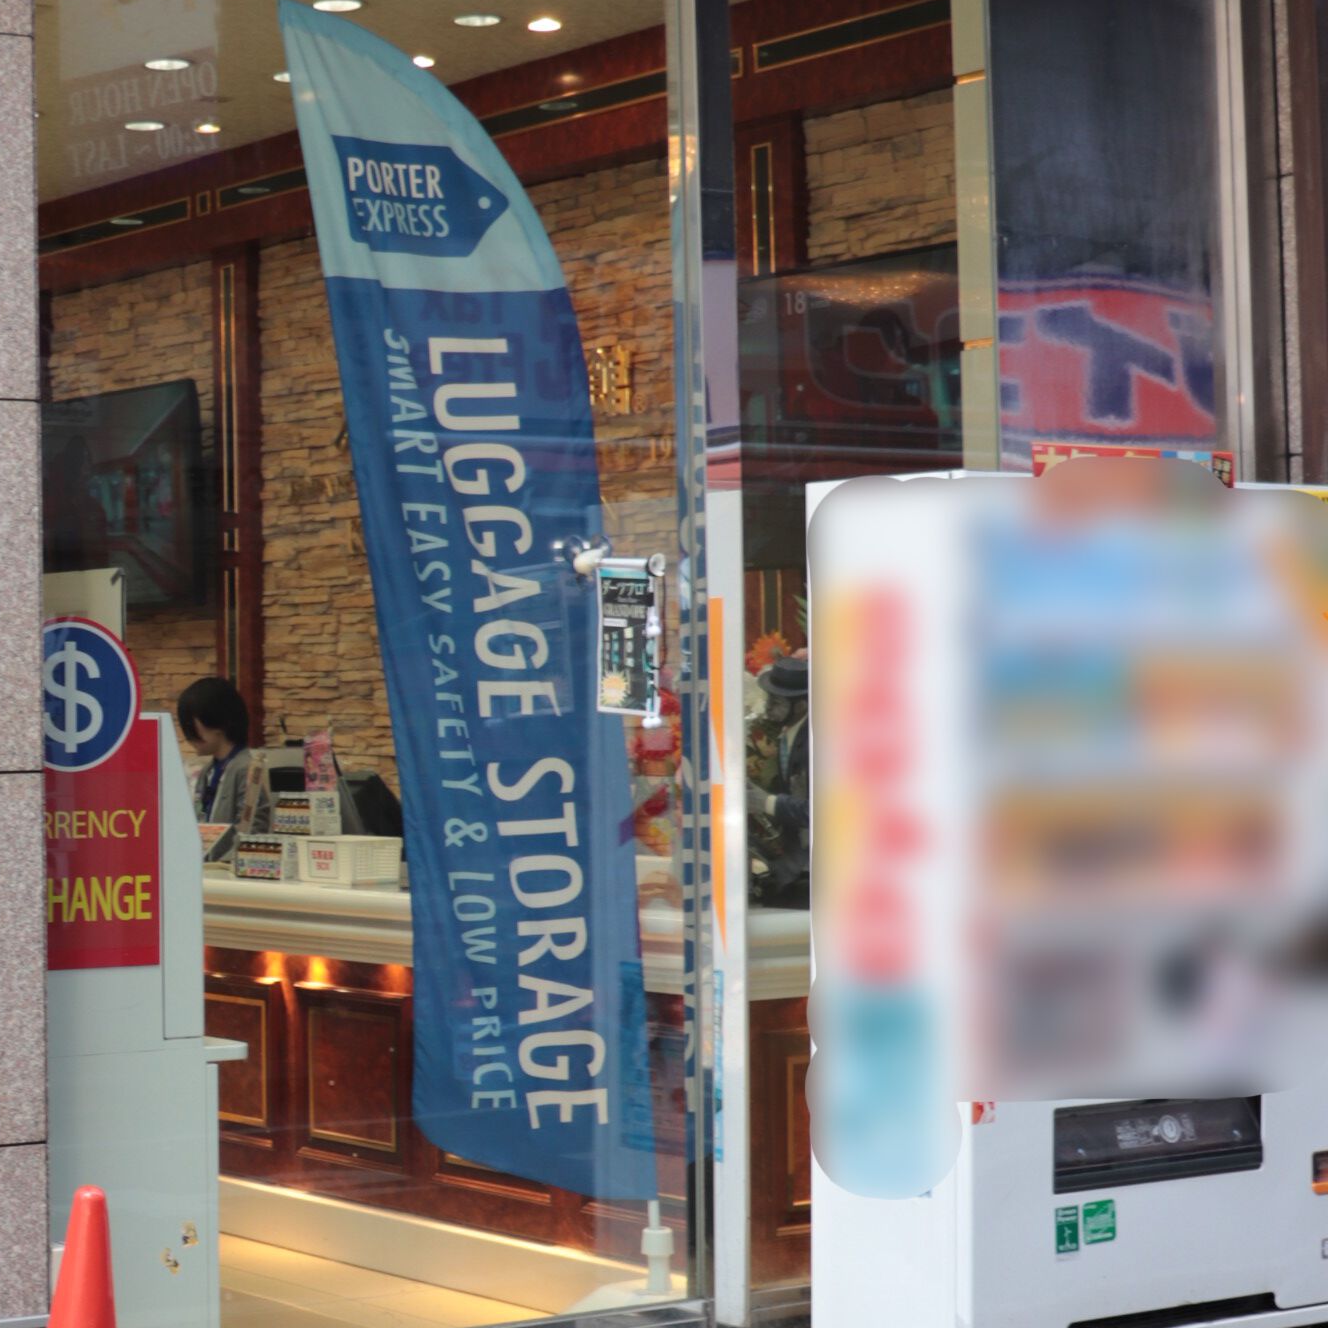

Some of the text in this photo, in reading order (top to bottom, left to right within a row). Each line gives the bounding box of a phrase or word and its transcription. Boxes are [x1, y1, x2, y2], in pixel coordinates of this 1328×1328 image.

[346, 156, 445, 200] PORTER
[383, 328, 517, 1111] SMART EASY SAFETY & LOW PRICE
[428, 336, 610, 1130] LUGGAGE STORAGE
